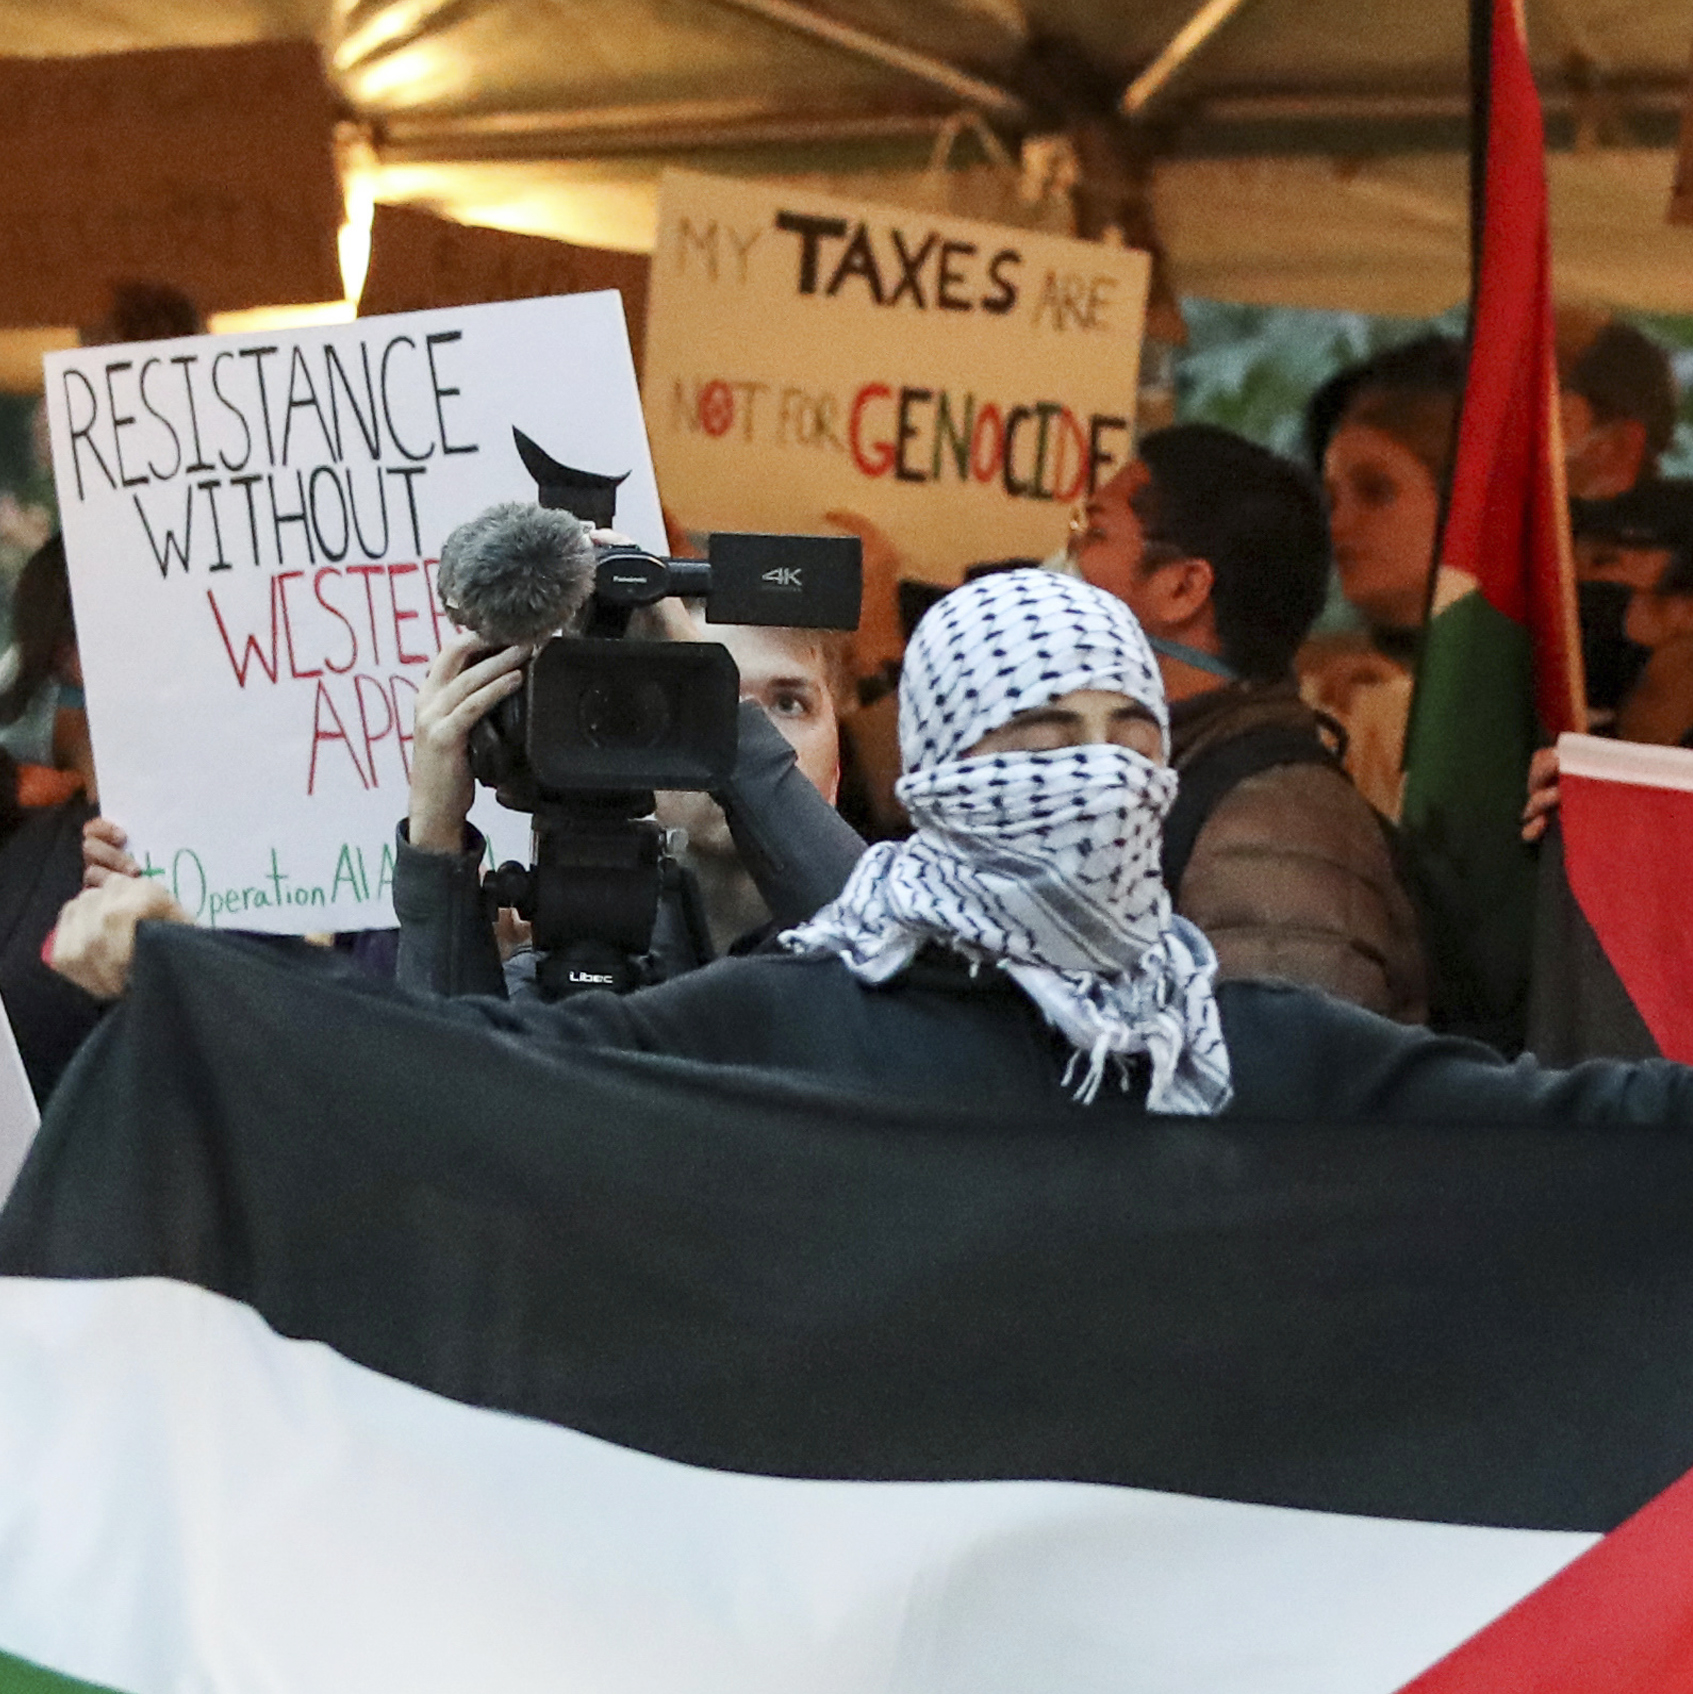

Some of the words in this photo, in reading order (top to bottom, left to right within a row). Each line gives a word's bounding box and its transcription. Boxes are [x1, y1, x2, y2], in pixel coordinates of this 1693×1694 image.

[679, 215, 763, 287] MY
[774, 209, 1023, 316] TAXES
[1032, 268, 1121, 334] ARE
[62, 330, 480, 502] RESISTANCE
[670, 377, 770, 444] NOT
[133, 465, 428, 580] WITHOUT
[761, 566, 803, 586] 4K
[568, 970, 614, 984] Libec
